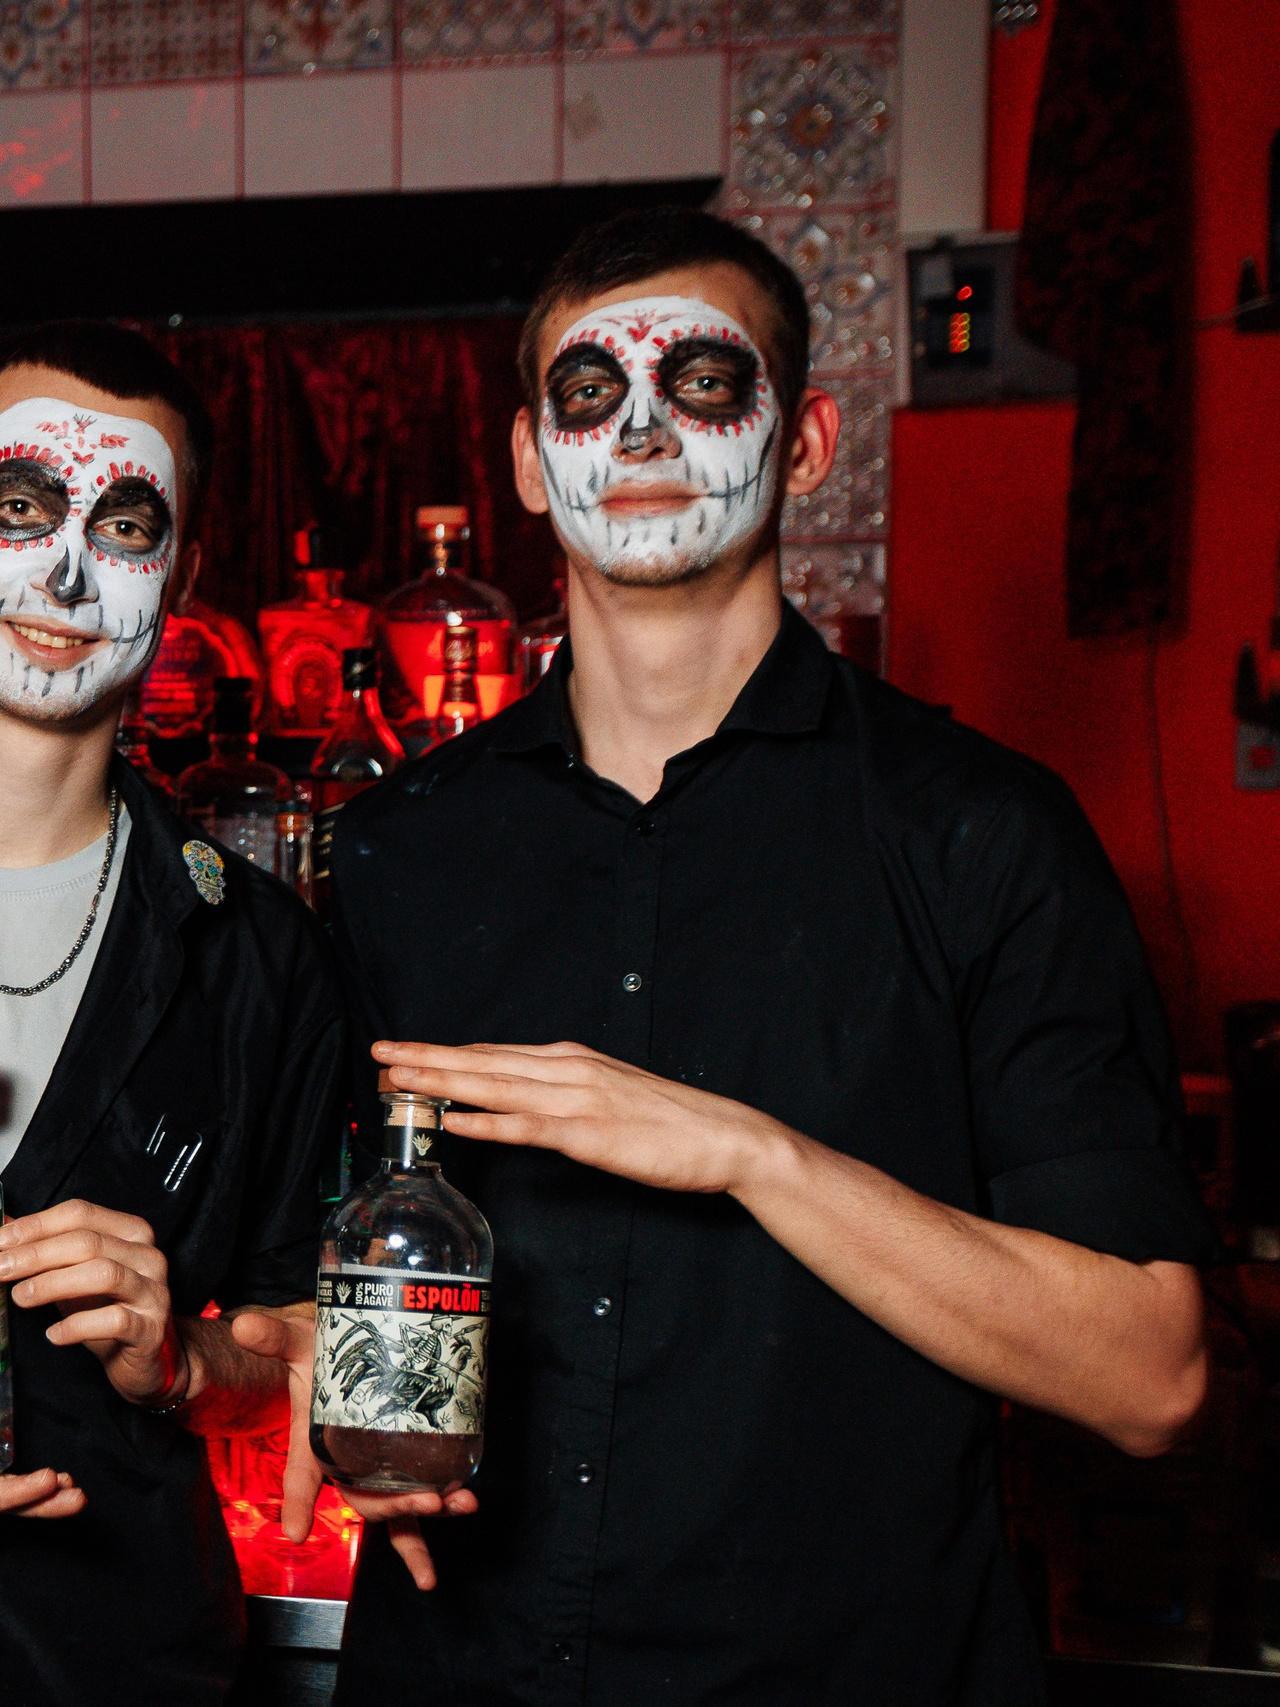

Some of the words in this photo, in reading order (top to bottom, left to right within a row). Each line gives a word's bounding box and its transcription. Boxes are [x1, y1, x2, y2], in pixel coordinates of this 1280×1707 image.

[355, 1282, 364, 1305] 100%
[364, 1282, 394, 1297] PURO
[363, 1295, 394, 1307] AGAVE
